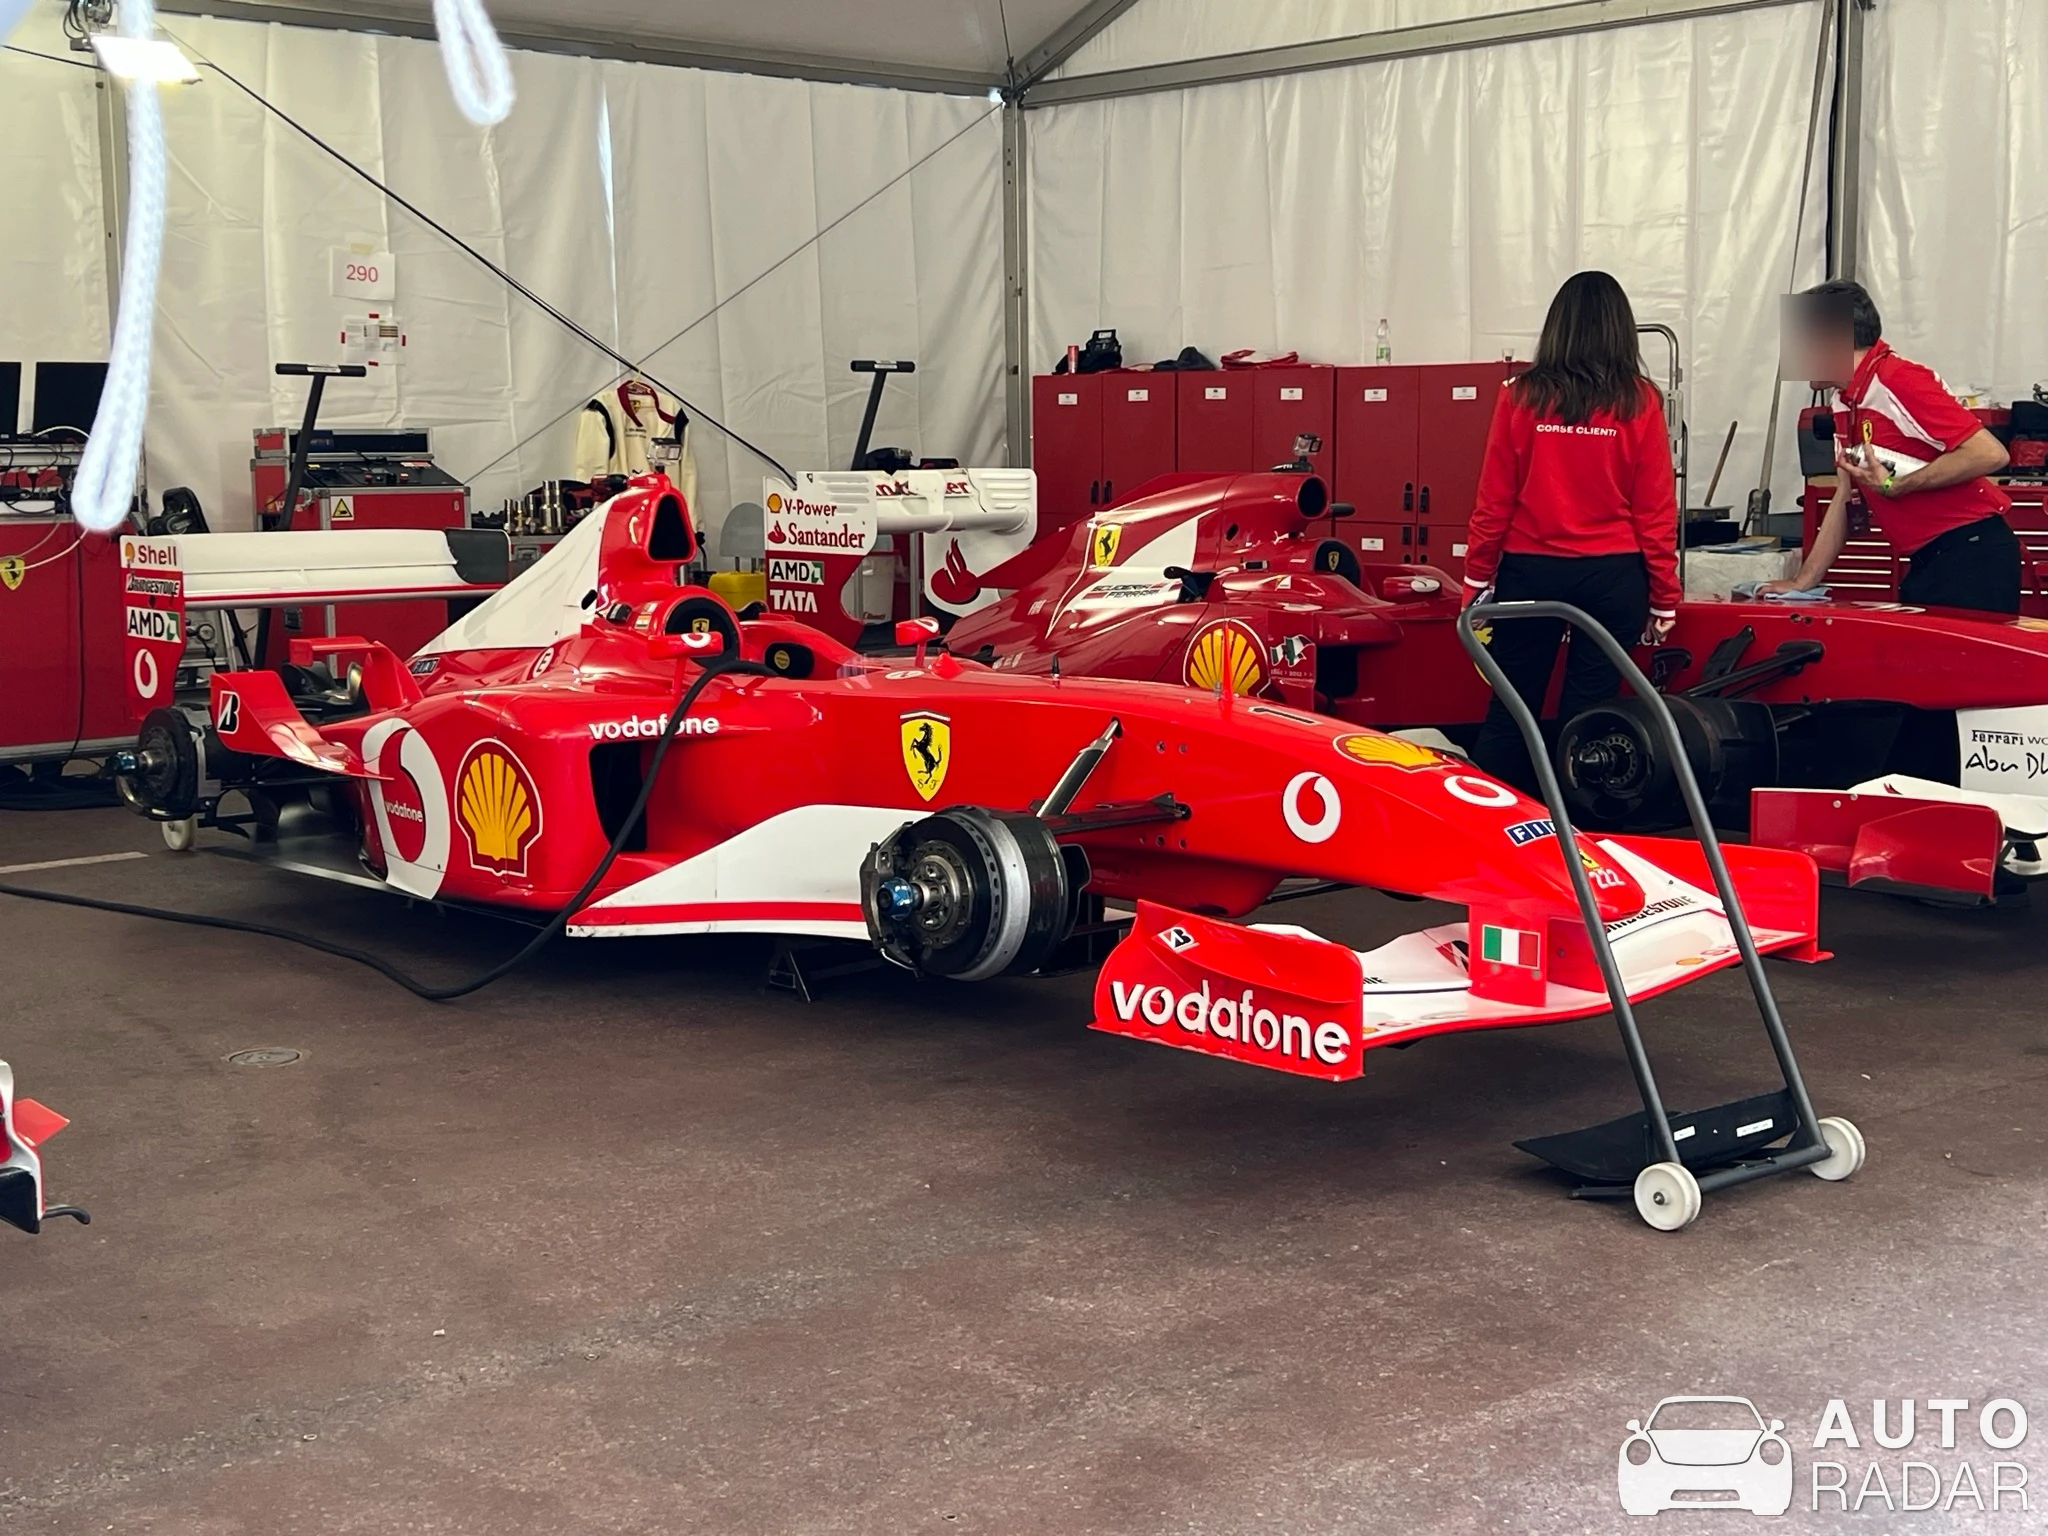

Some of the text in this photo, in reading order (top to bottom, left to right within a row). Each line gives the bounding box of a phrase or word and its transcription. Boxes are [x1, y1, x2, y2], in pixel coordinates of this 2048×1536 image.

[346, 264, 379, 283] 290
[1536, 424, 1617, 437] CORSE CLIENTI
[784, 498, 838, 516] V-Power
[788, 522, 866, 549] Santander
[138, 545, 177, 567] Shell
[770, 561, 810, 582] AMD
[127, 575, 179, 595] BRIDGESTONE
[769, 589, 818, 613] TATA
[128, 609, 165, 638] AMD
[411, 659, 437, 674] FIAT
[1971, 729, 2024, 746] Ferrari
[1965, 744, 2019, 773] Abu
[384, 800, 424, 823] vodafone
[1111, 979, 1351, 1065] vodafone
